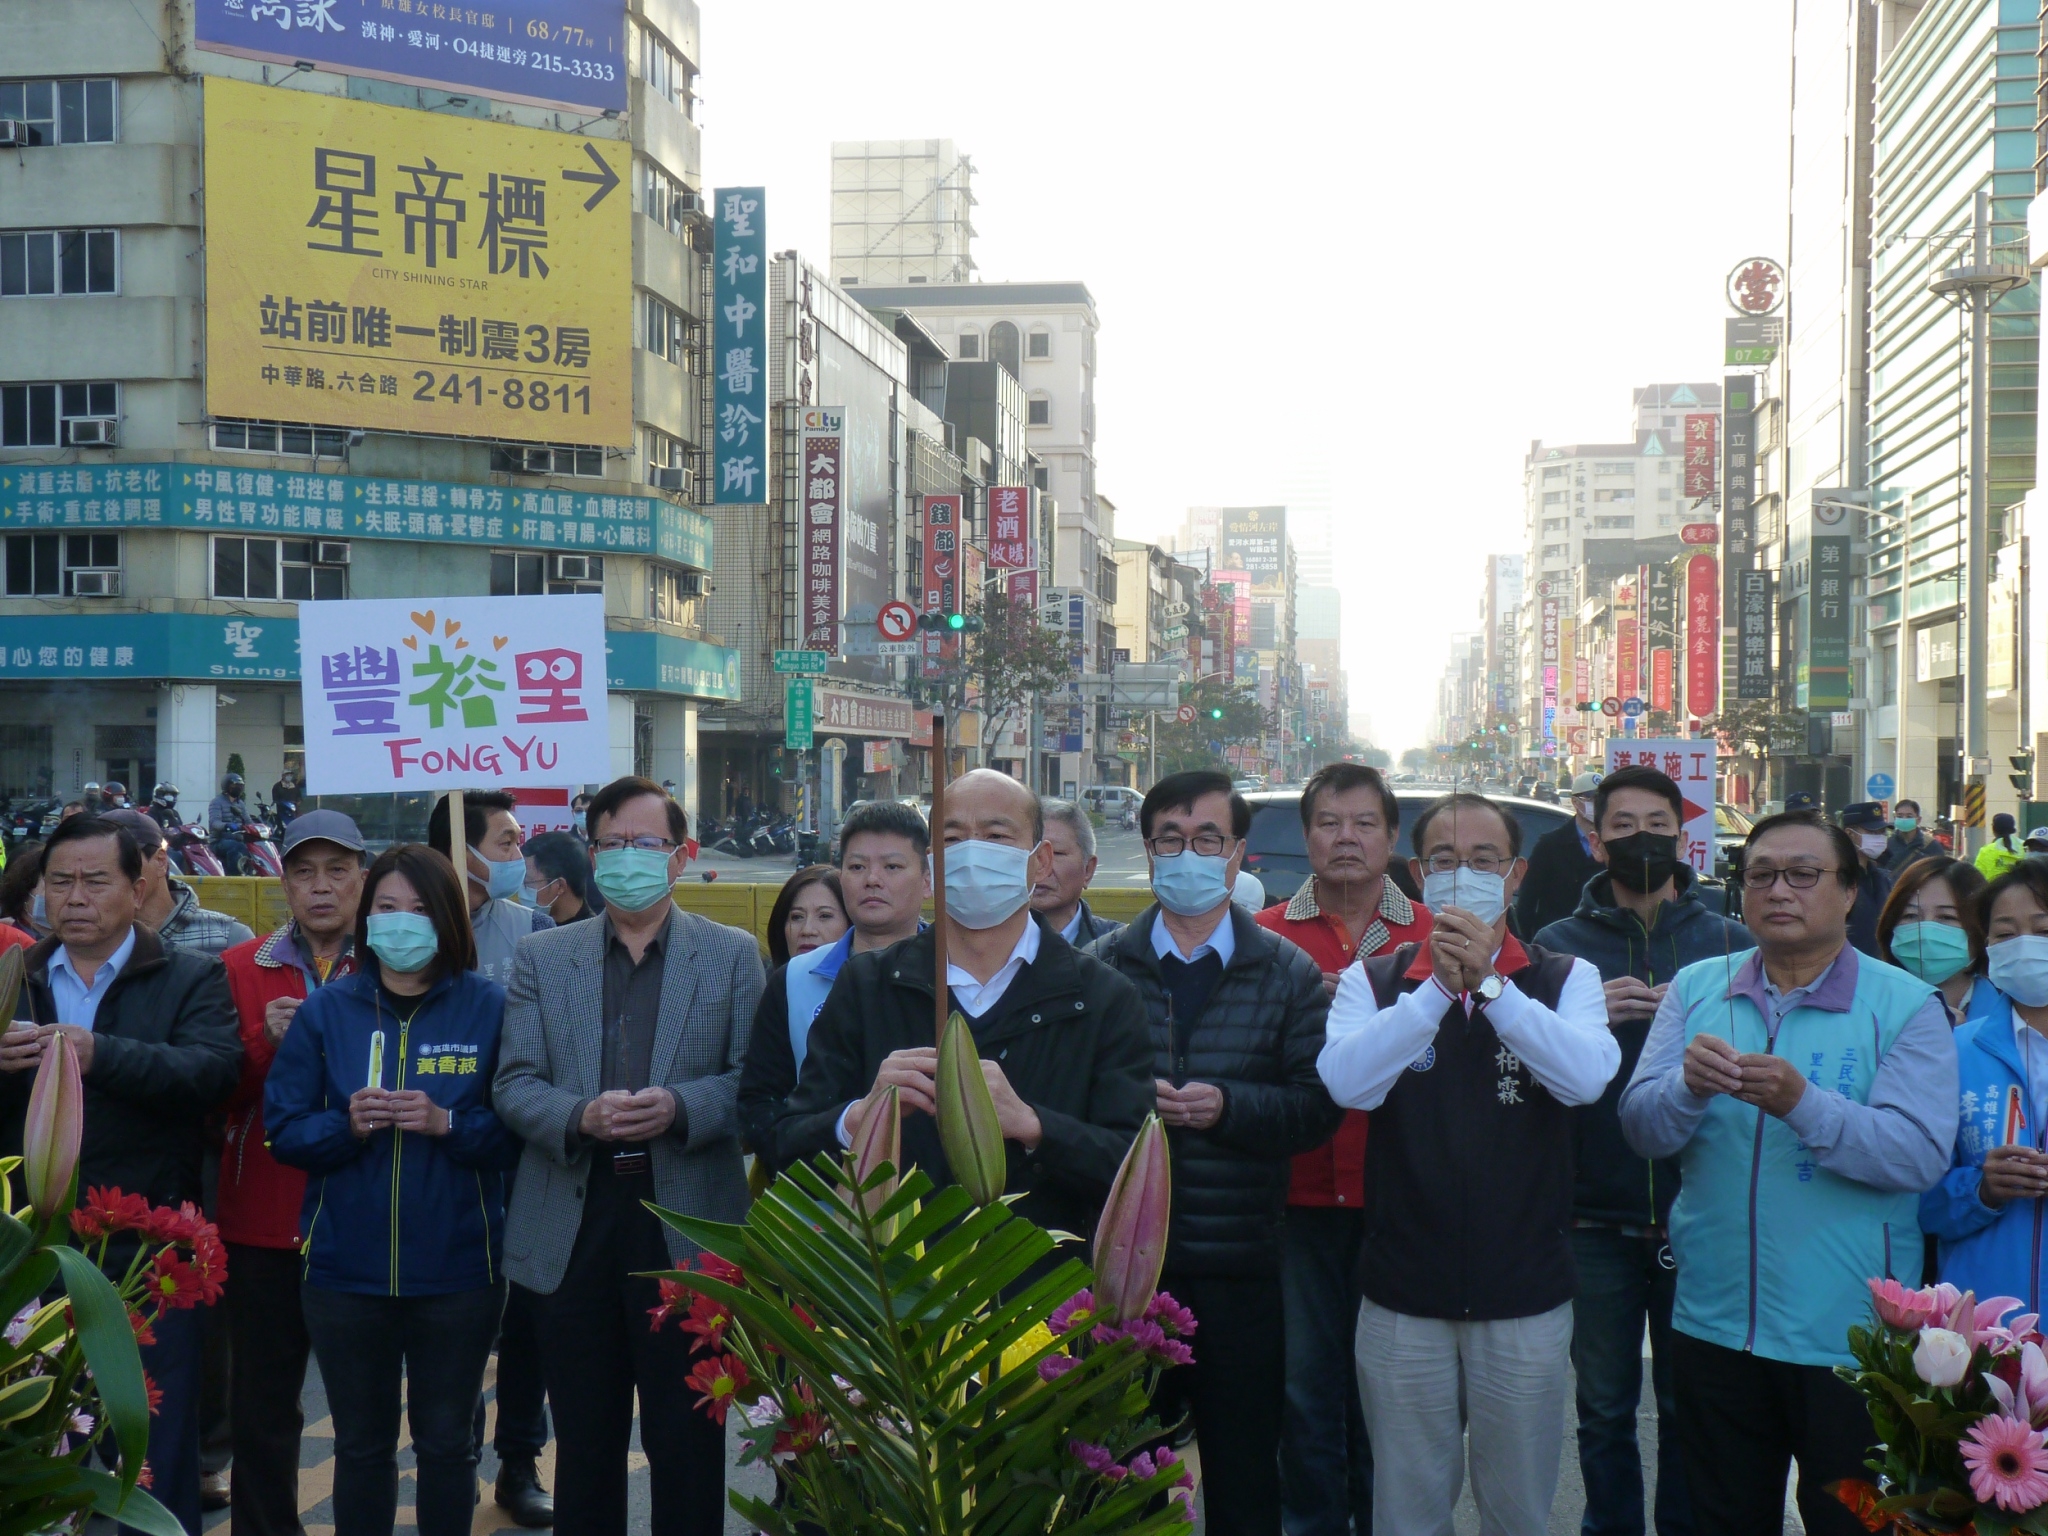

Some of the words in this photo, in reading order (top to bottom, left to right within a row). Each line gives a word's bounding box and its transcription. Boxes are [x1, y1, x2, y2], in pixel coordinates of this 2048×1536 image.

[531, 52, 615, 82] 215-3333
[305, 146, 550, 280] 星帝標
[371, 267, 399, 282] CITY
[403, 271, 456, 288] SHINING
[459, 277, 489, 291] STAR
[259, 293, 592, 369] 站前唯一制震3房
[718, 193, 762, 498] 聖和中醫診所
[412, 370, 591, 416] 241-8811
[805, 411, 842, 432] City
[808, 453, 836, 525] 大都會
[194, 499, 345, 530] 男性腎功能障礙
[930, 502, 956, 552] 錢都
[996, 490, 1020, 538] 老酒
[990, 541, 1025, 564] 收購
[811, 528, 832, 642] 網路咖啡美食館
[943, 583, 953, 609] CASH
[1820, 545, 1840, 619] 第一銀行
[1650, 570, 1670, 650] 上仁診
[1688, 840, 1707, 870] 行
[416, 1056, 478, 1075] 黃香菽
[1959, 1090, 1982, 1166] 李雅
